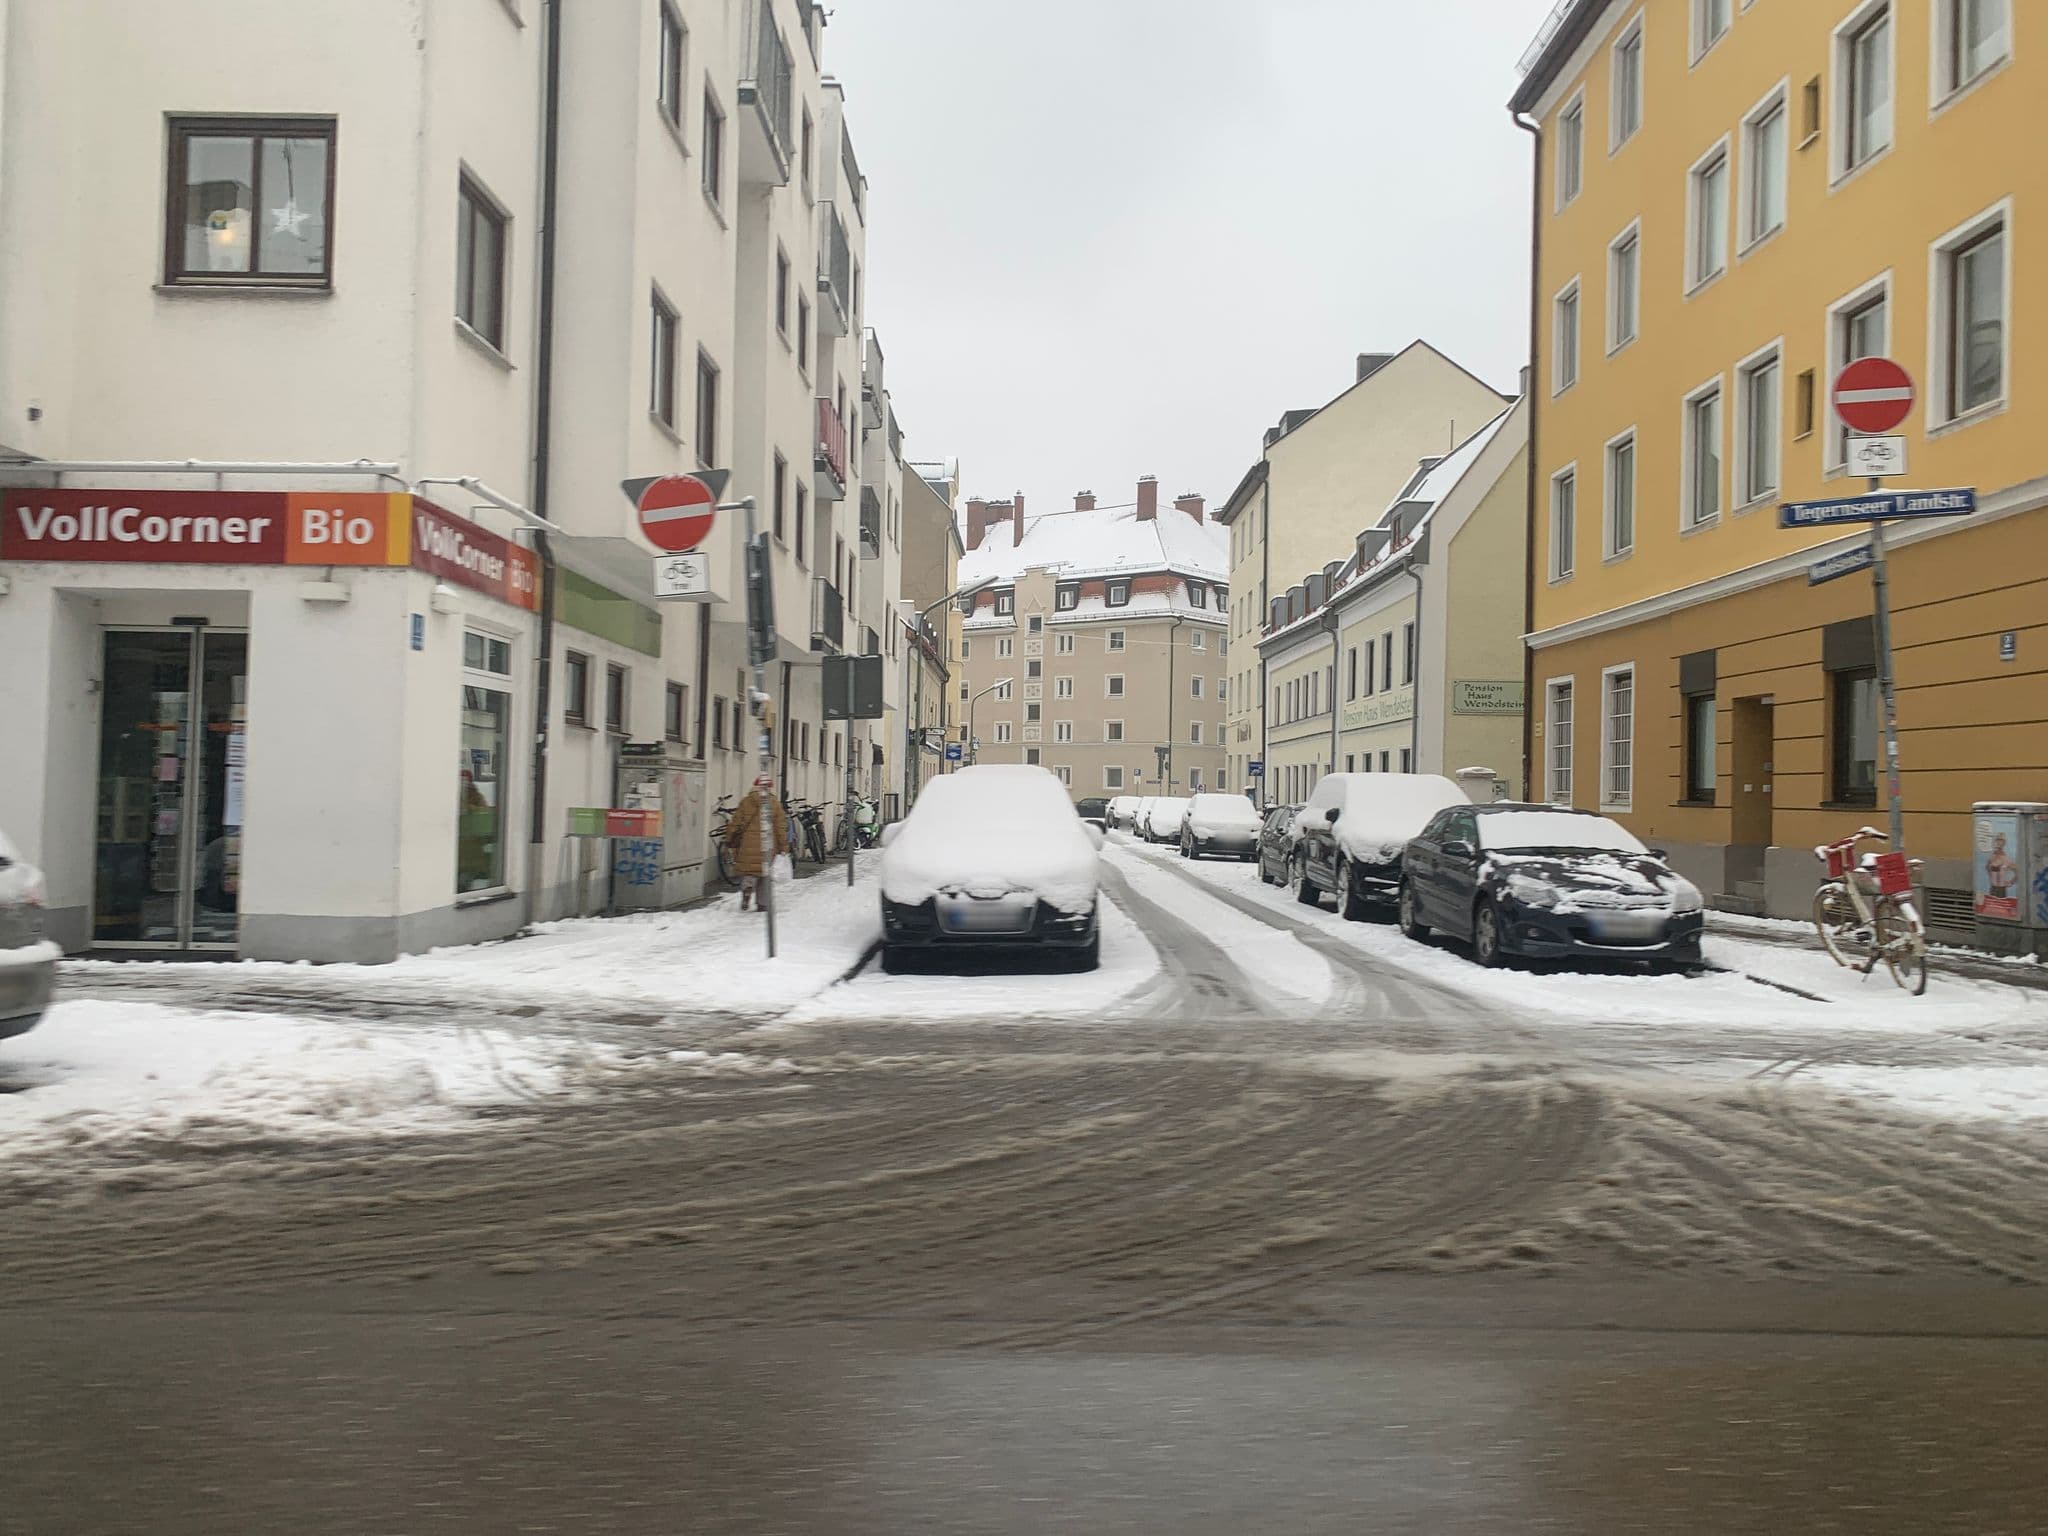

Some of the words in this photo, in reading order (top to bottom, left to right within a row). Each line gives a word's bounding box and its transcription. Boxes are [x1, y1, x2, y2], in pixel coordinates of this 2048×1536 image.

[1792, 501, 1892, 521] Tegernseer
[1896, 493, 1968, 512] Landstr.
[17, 505, 272, 545] VollCorner
[301, 508, 375, 545] Bio
[416, 515, 505, 581] VollCorner
[511, 558, 533, 593] Bio
[1464, 684, 1503, 692] Pension
[1364, 704, 1378, 721] Haus
